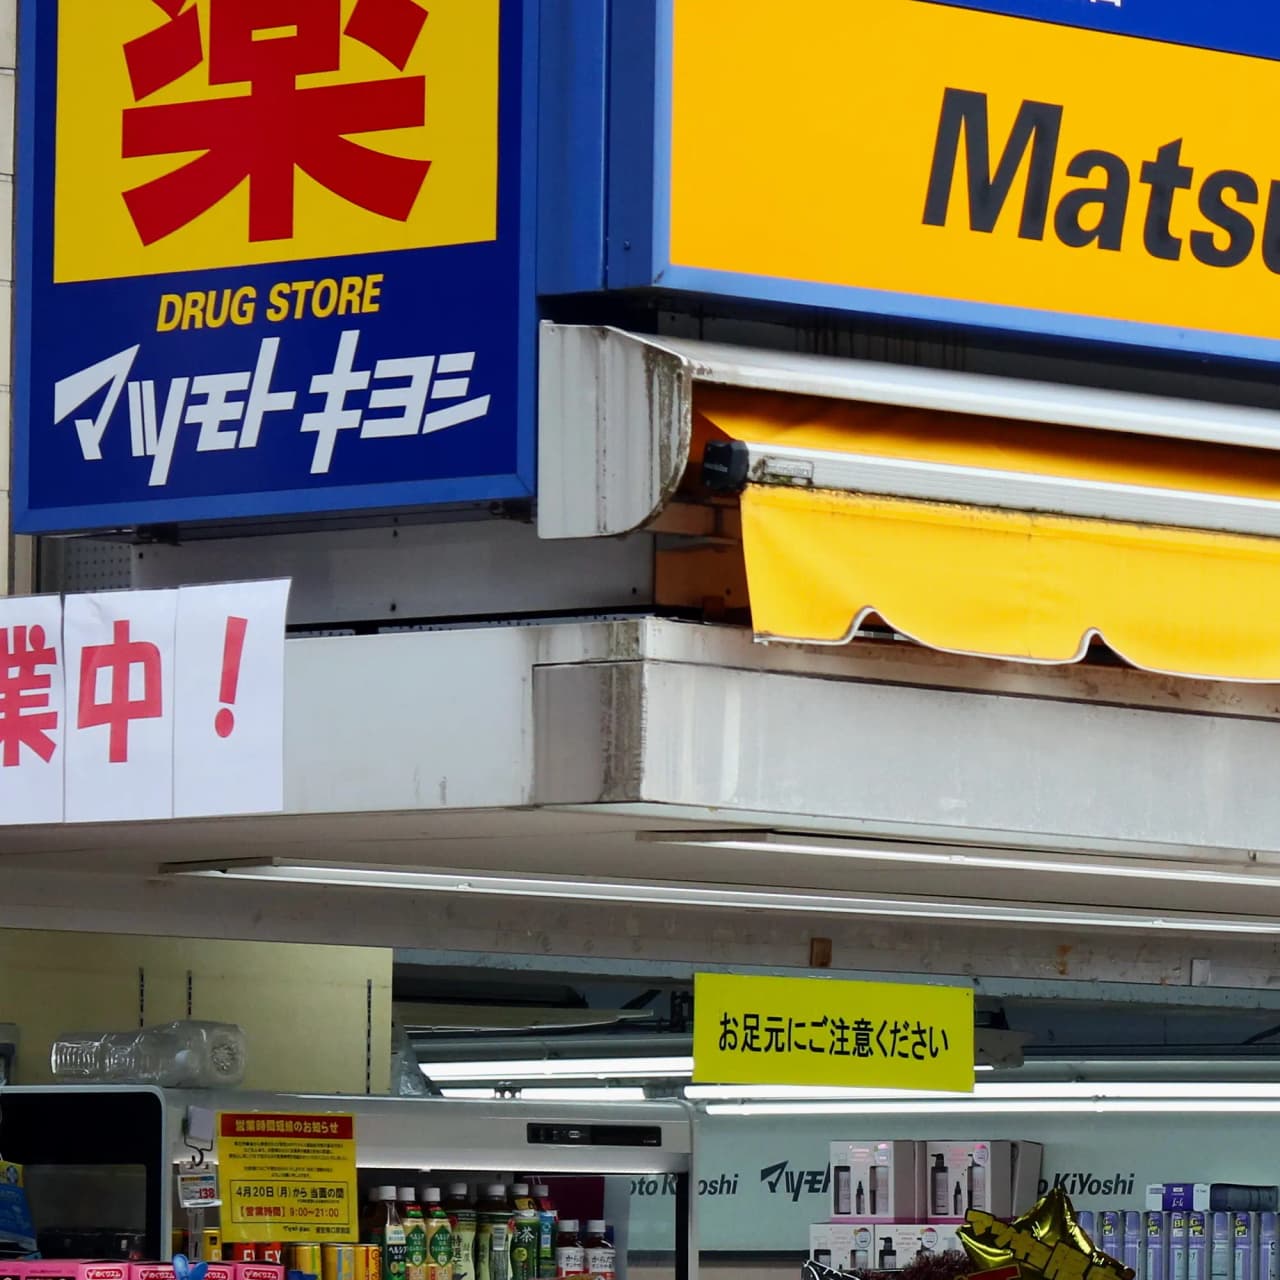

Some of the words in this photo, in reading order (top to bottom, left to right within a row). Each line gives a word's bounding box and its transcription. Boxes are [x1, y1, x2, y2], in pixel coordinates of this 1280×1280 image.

[156, 283, 255, 332] DRUG
[266, 273, 384, 322] STORE
[55, 330, 490, 487] マツモトキヨシ
[718, 1012, 949, 1060] お足元にご注意ください
[1053, 1173, 1134, 1196] KiYoshi
